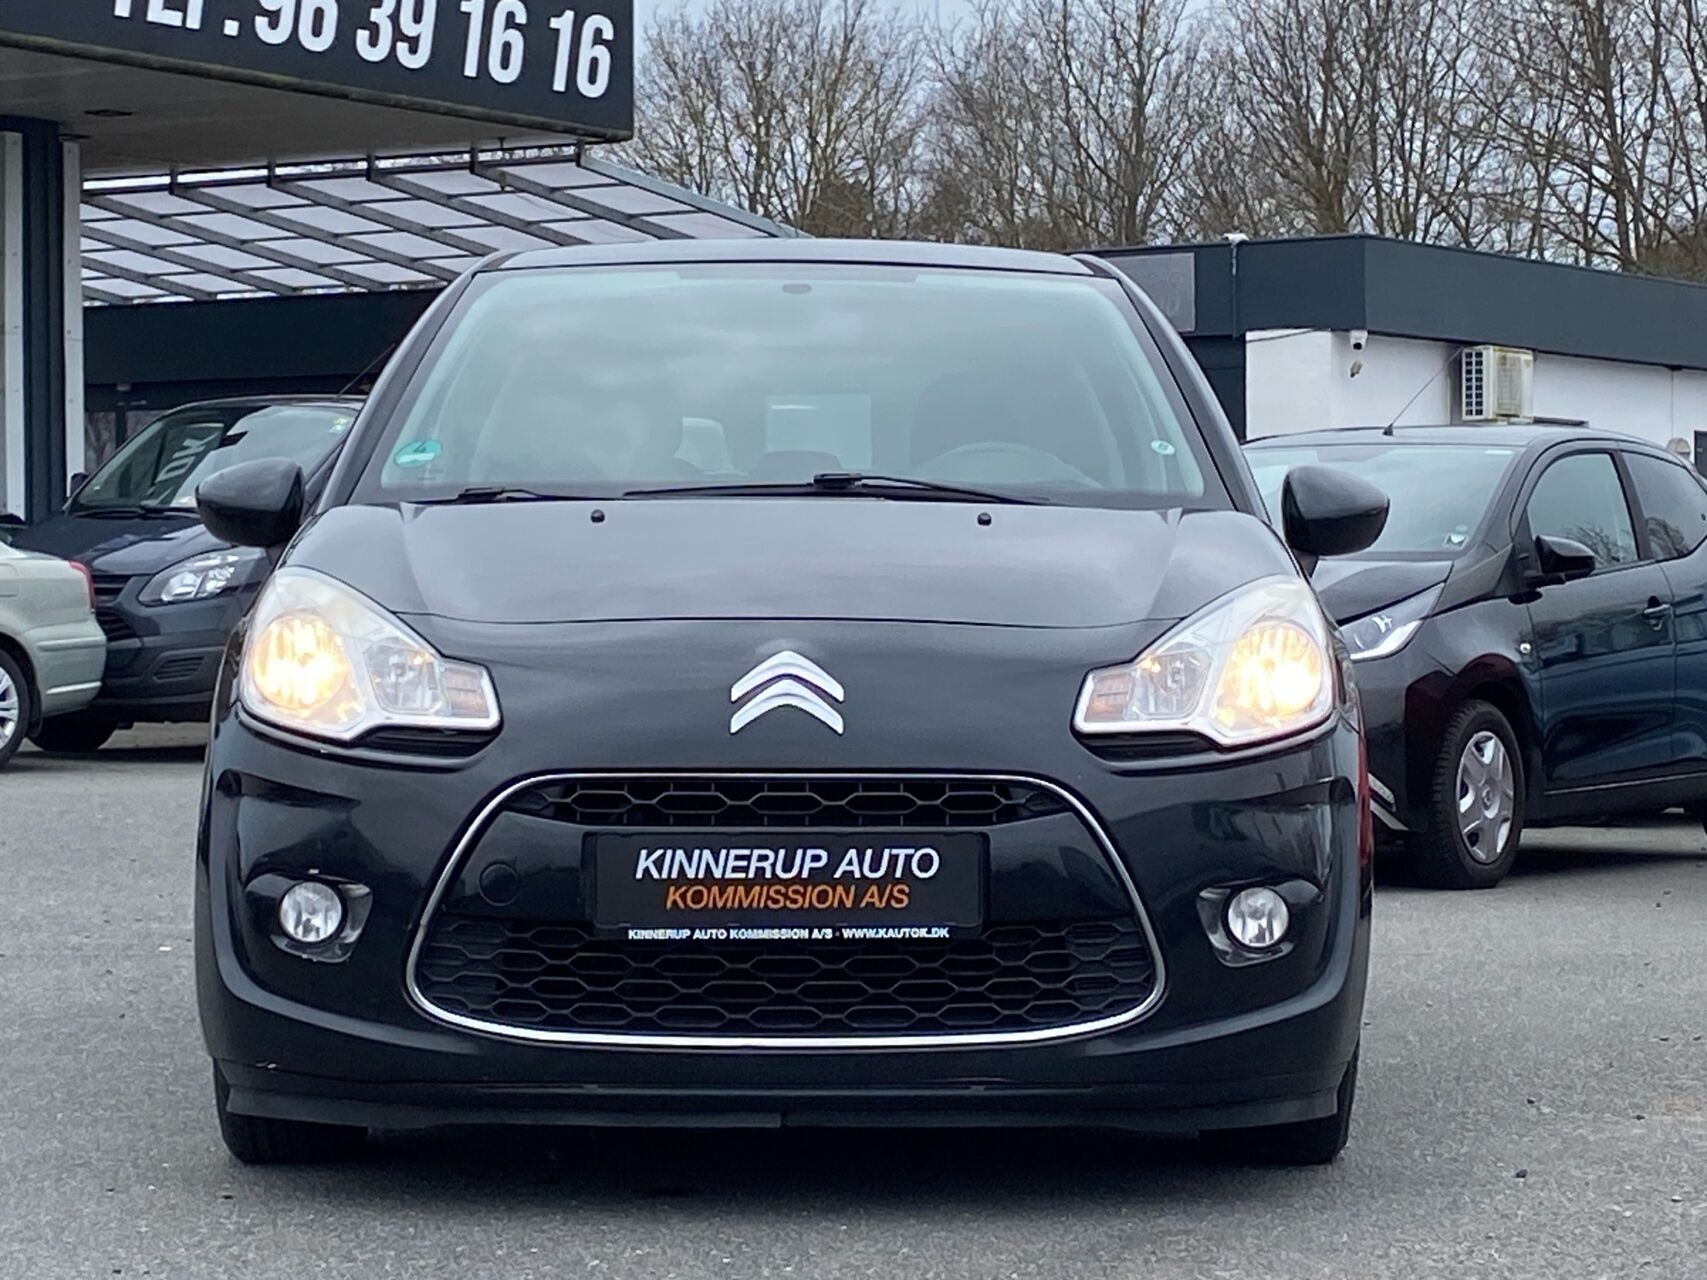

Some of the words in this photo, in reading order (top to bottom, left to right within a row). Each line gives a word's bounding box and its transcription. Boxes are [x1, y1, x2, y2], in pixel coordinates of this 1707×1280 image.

[254, 0, 339, 52] 96
[355, 0, 437, 69] 39
[459, 0, 528, 84] 16
[549, 9, 615, 99] 16
[635, 848, 828, 880] KINNERUP
[834, 848, 940, 880] AUTO
[666, 885, 855, 911] KOMMISSION
[860, 884, 910, 909] A/S
[628, 929, 691, 940] KINNERUP
[692, 929, 728, 940] AUTO
[729, 929, 809, 940] KOMMISSION
[811, 928, 833, 940] A/S
